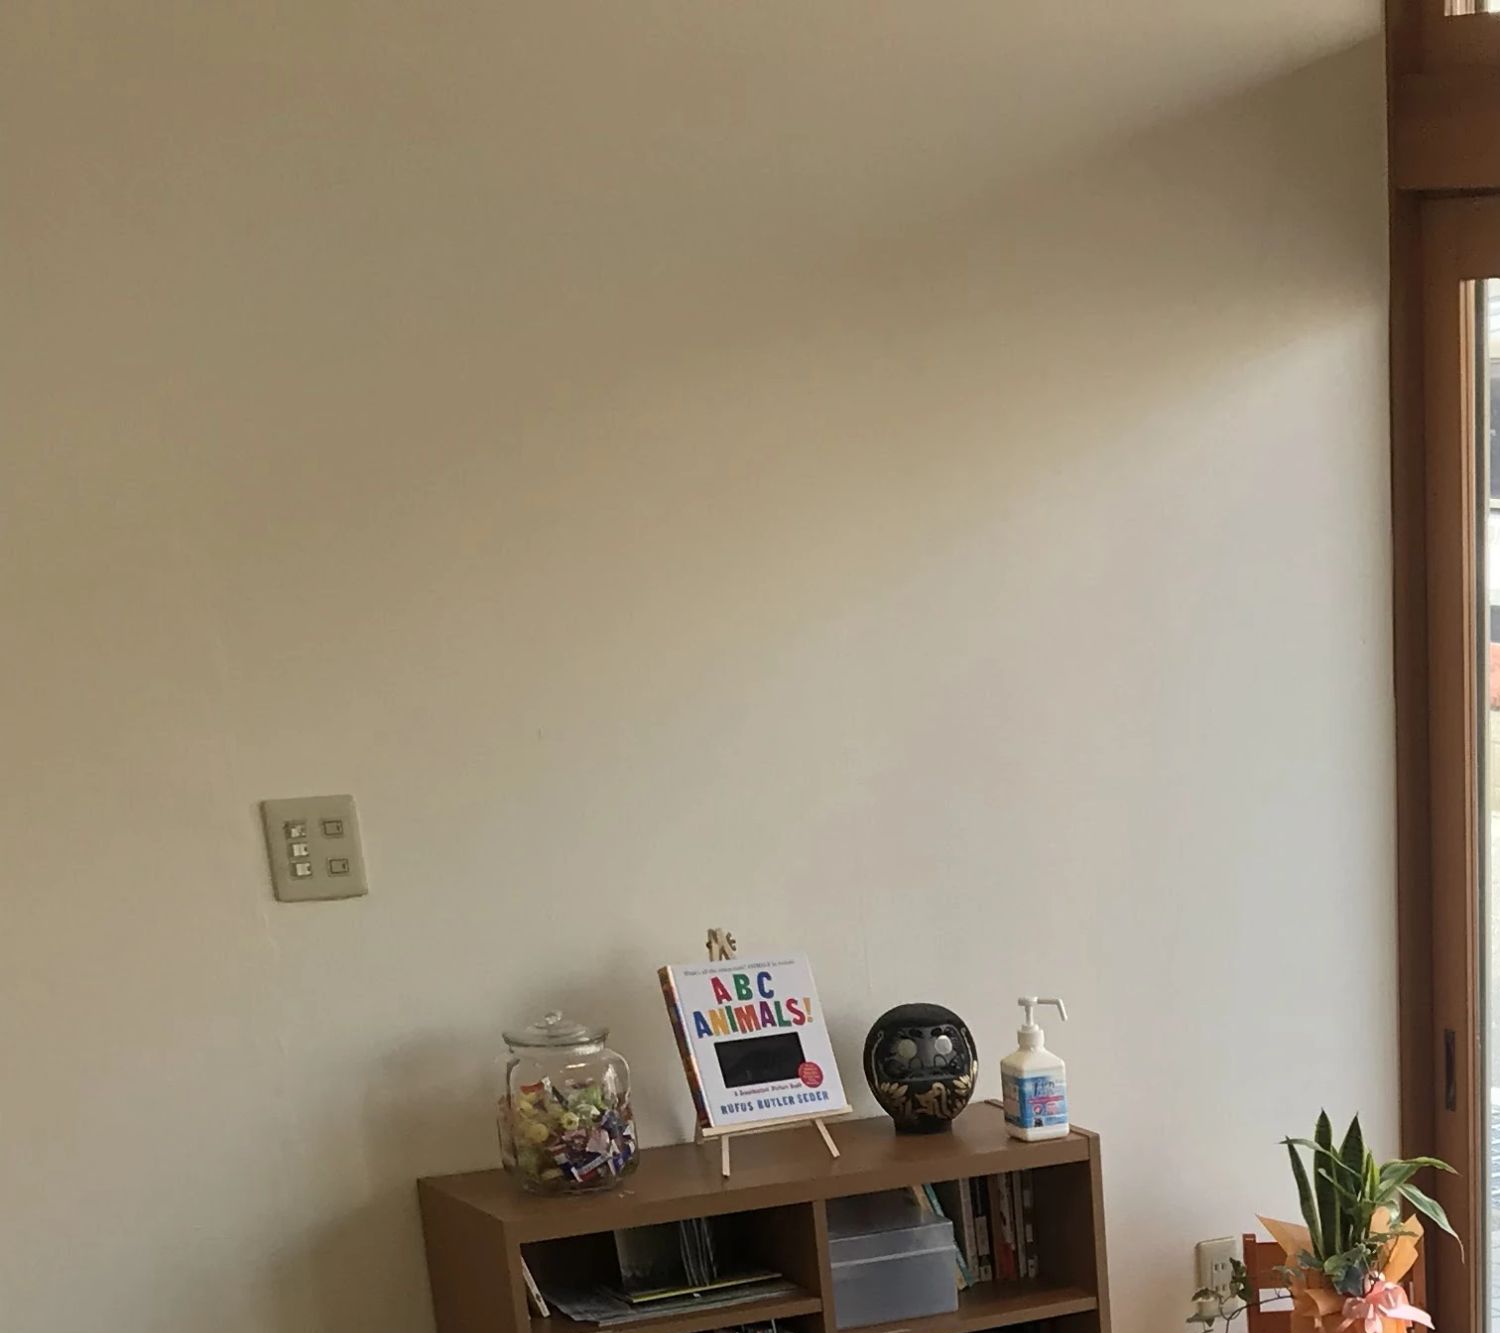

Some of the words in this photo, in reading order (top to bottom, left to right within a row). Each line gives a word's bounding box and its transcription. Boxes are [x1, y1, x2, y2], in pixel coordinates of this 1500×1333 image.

[693, 997, 813, 1038] ANIMALS!
[720, 1101, 754, 1115] RUFUS
[757, 1095, 795, 1110] BUTLER
[798, 1090, 829, 1104] SEDER
